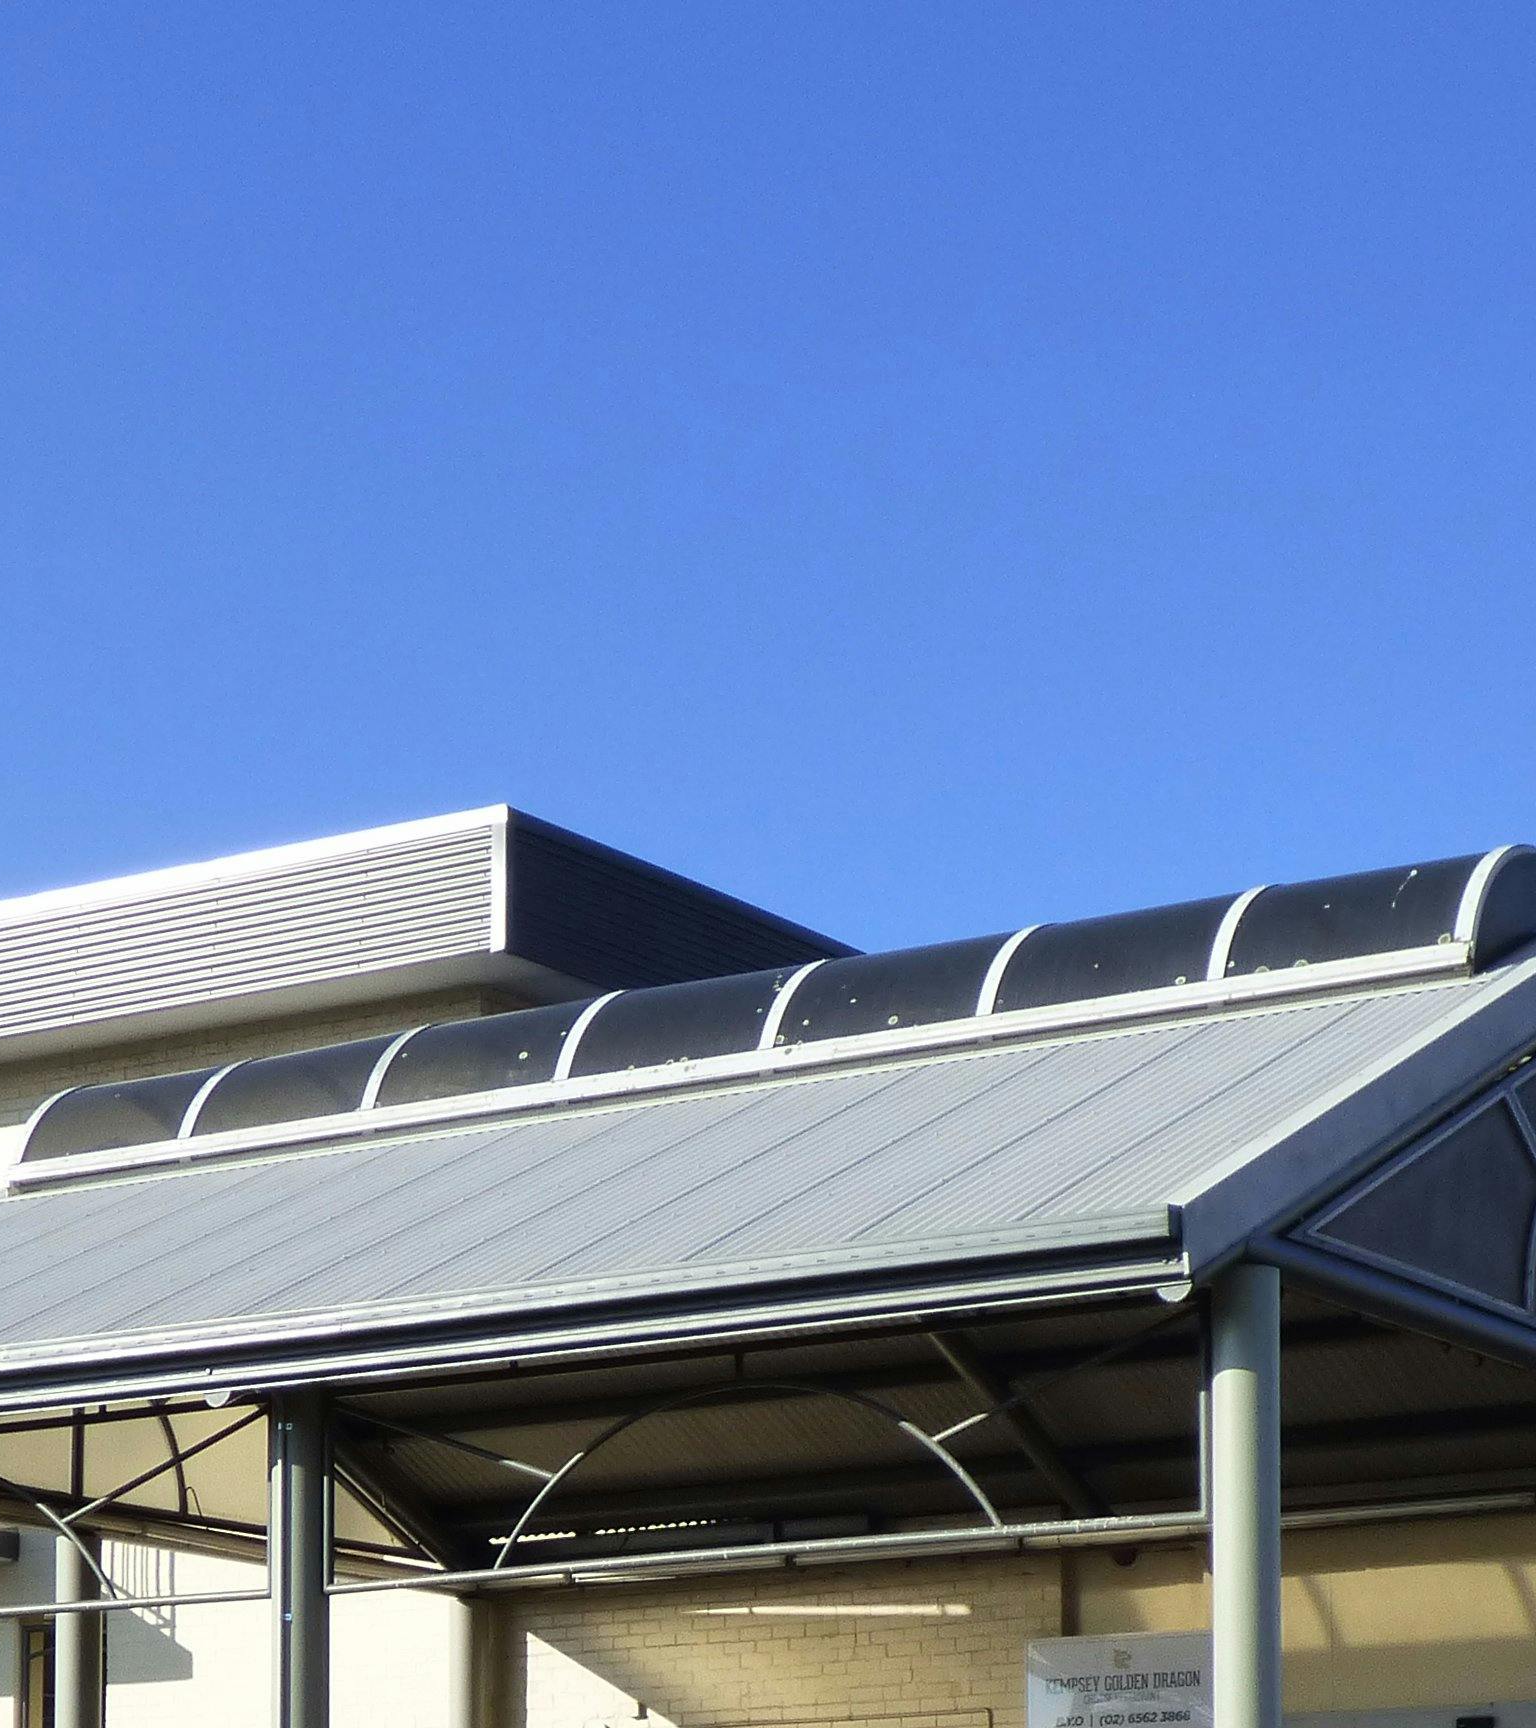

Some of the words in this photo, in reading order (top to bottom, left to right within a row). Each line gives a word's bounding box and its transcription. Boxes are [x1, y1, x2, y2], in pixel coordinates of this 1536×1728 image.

[1103, 1672, 1150, 1692] GOLDEN
[1152, 1669, 1201, 1689] DRAGON
[1099, 1713, 1125, 1727] (02)
[1127, 1711, 1158, 1724] 6562
